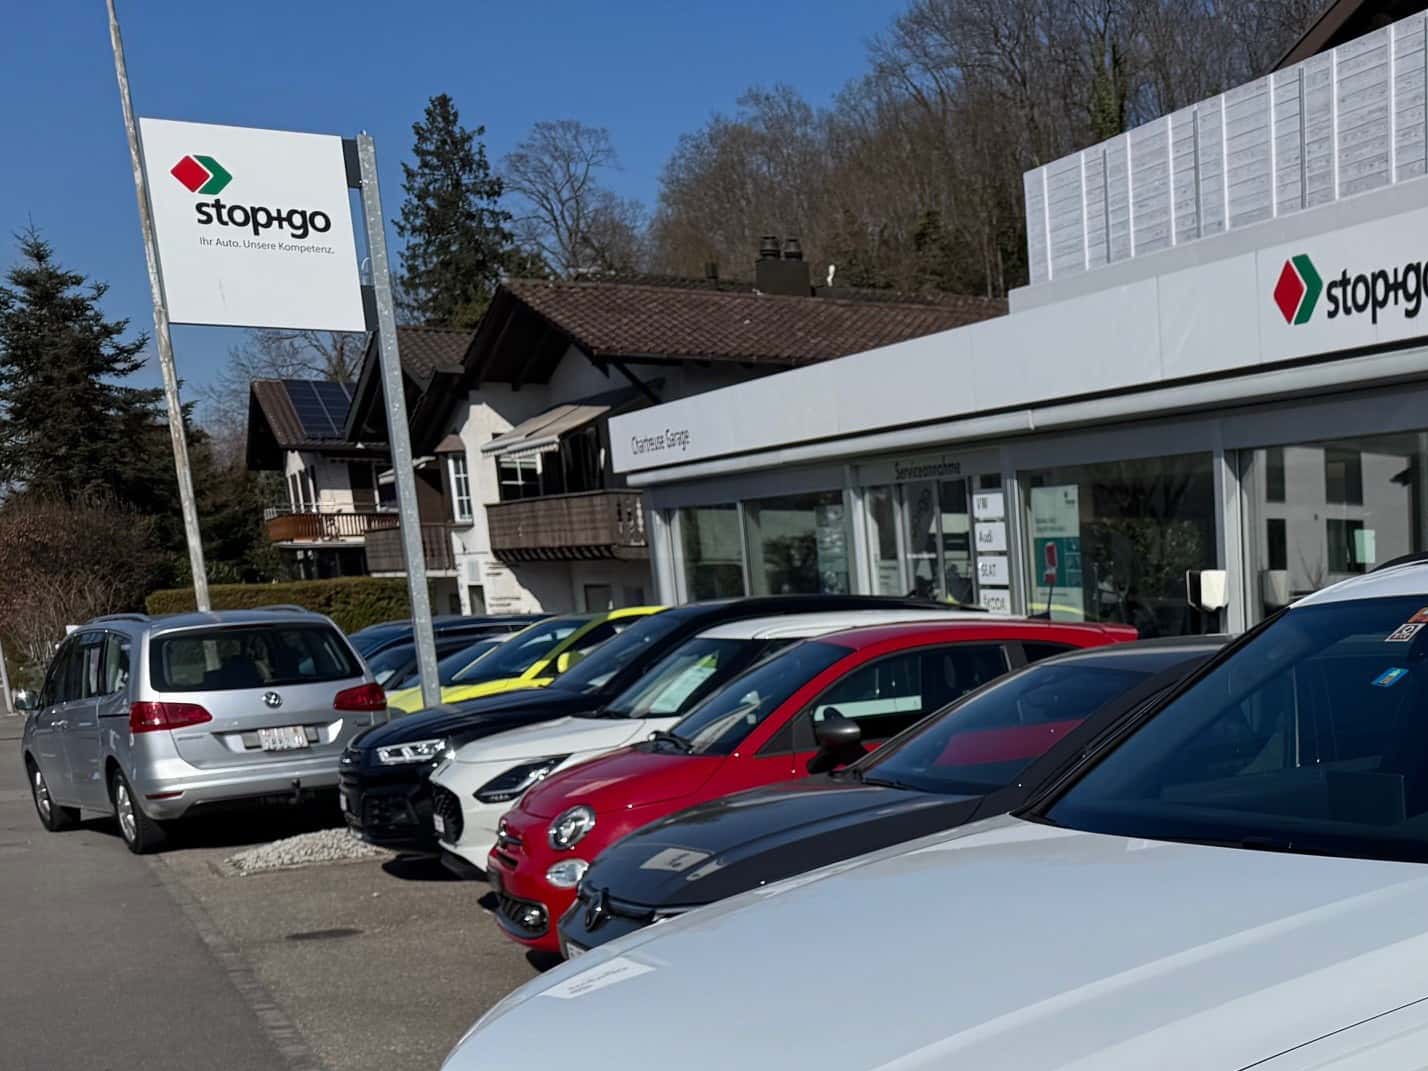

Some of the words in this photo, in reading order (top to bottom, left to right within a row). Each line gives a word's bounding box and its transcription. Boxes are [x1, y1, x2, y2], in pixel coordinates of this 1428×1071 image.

[195, 198, 332, 240] stop+go
[199, 237, 213, 247] Ihr
[216, 238, 241, 249] Auto.
[243, 240, 277, 251] Unsere
[279, 242, 335, 255] Kompetenz.
[665, 428, 690, 452] Garage
